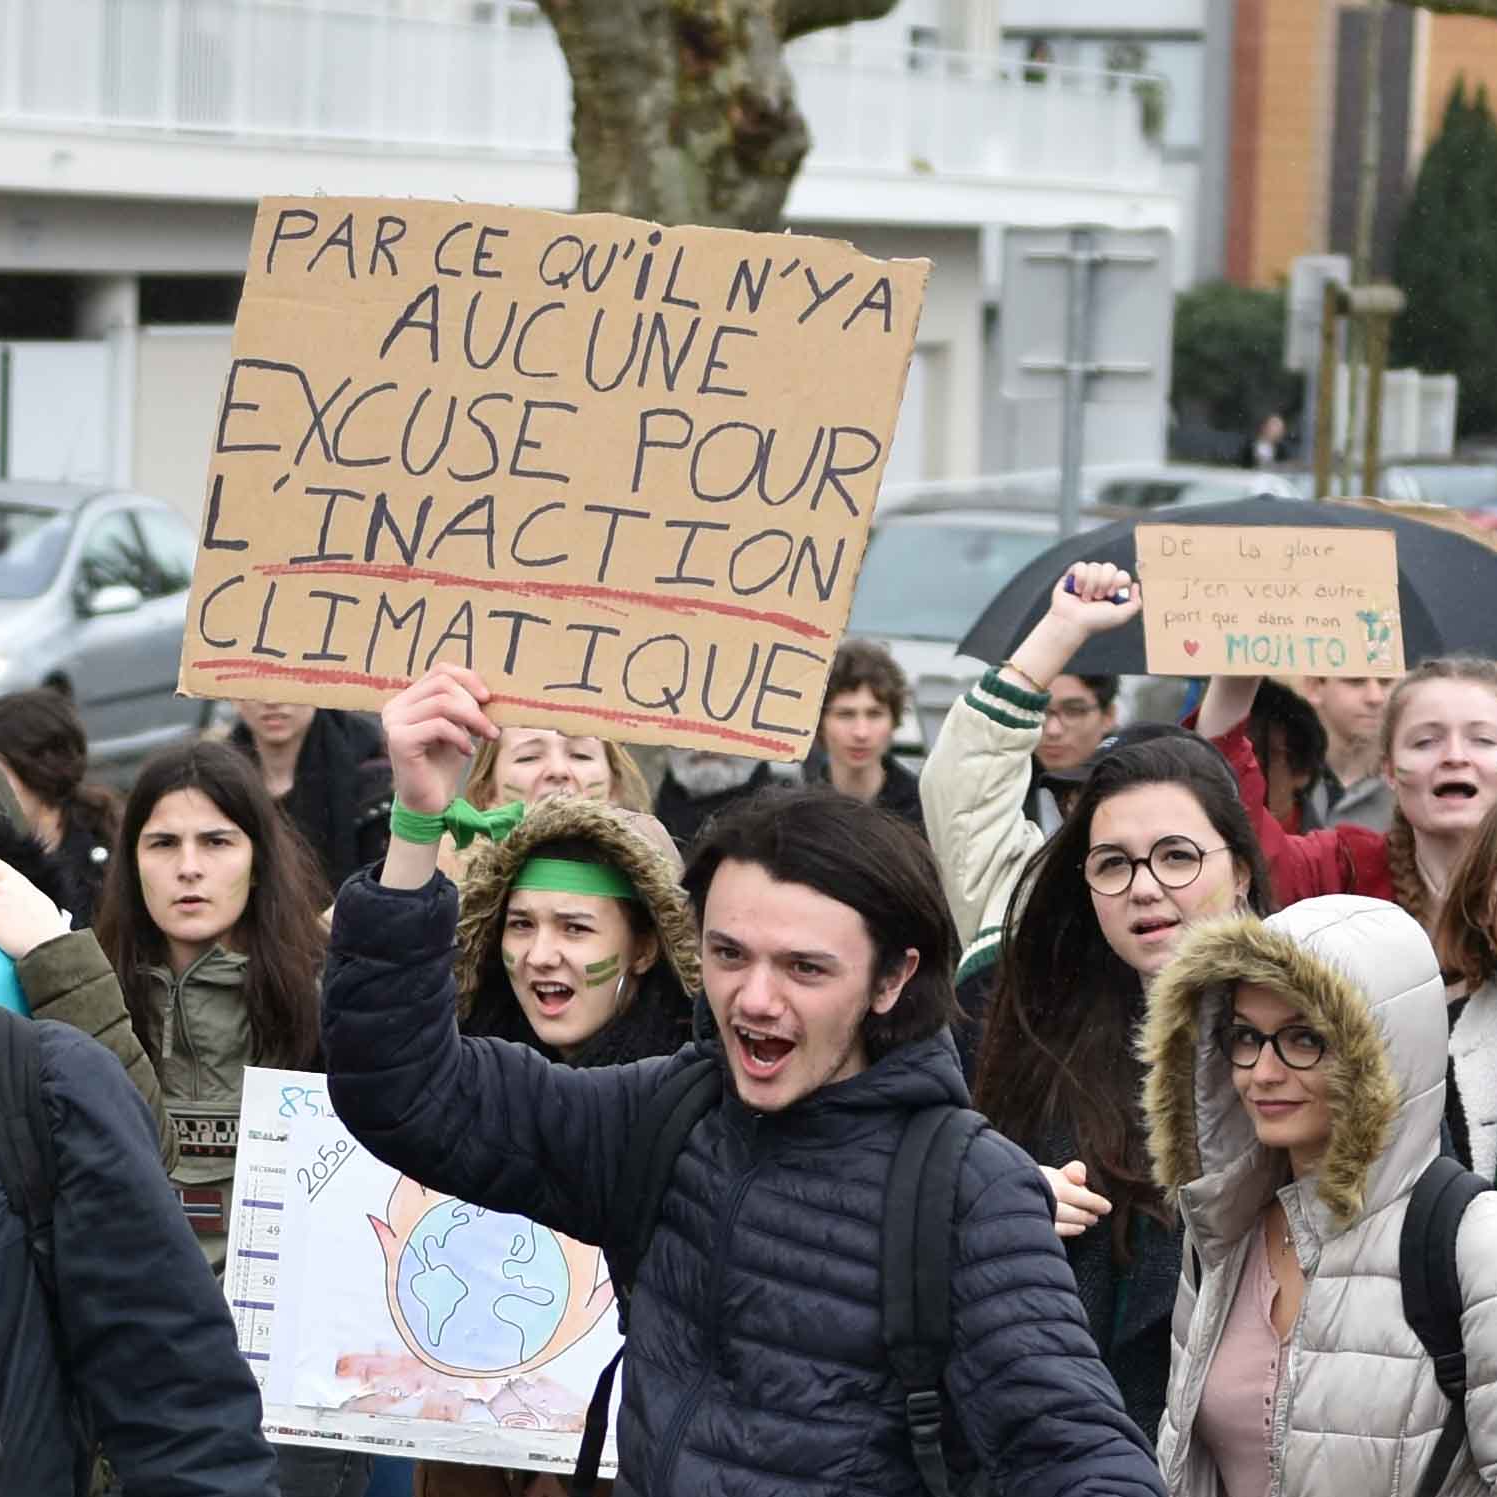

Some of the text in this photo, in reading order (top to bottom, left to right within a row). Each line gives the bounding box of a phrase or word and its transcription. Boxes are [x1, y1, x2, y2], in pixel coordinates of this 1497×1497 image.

[268, 209, 407, 280] PAR
[434, 221, 508, 280] CE
[380, 284, 758, 396] AUCUNE
[216, 358, 881, 517] EXCUSE POUR
[203, 473, 845, 601] L'INACTION
[199, 574, 827, 738] CLIMATIQUE
[296, 1139, 349, 1196] 2050
[266, 1225, 281, 1237] 49
[262, 1275, 276, 1286] 50
[257, 1326, 270, 1337] 51
